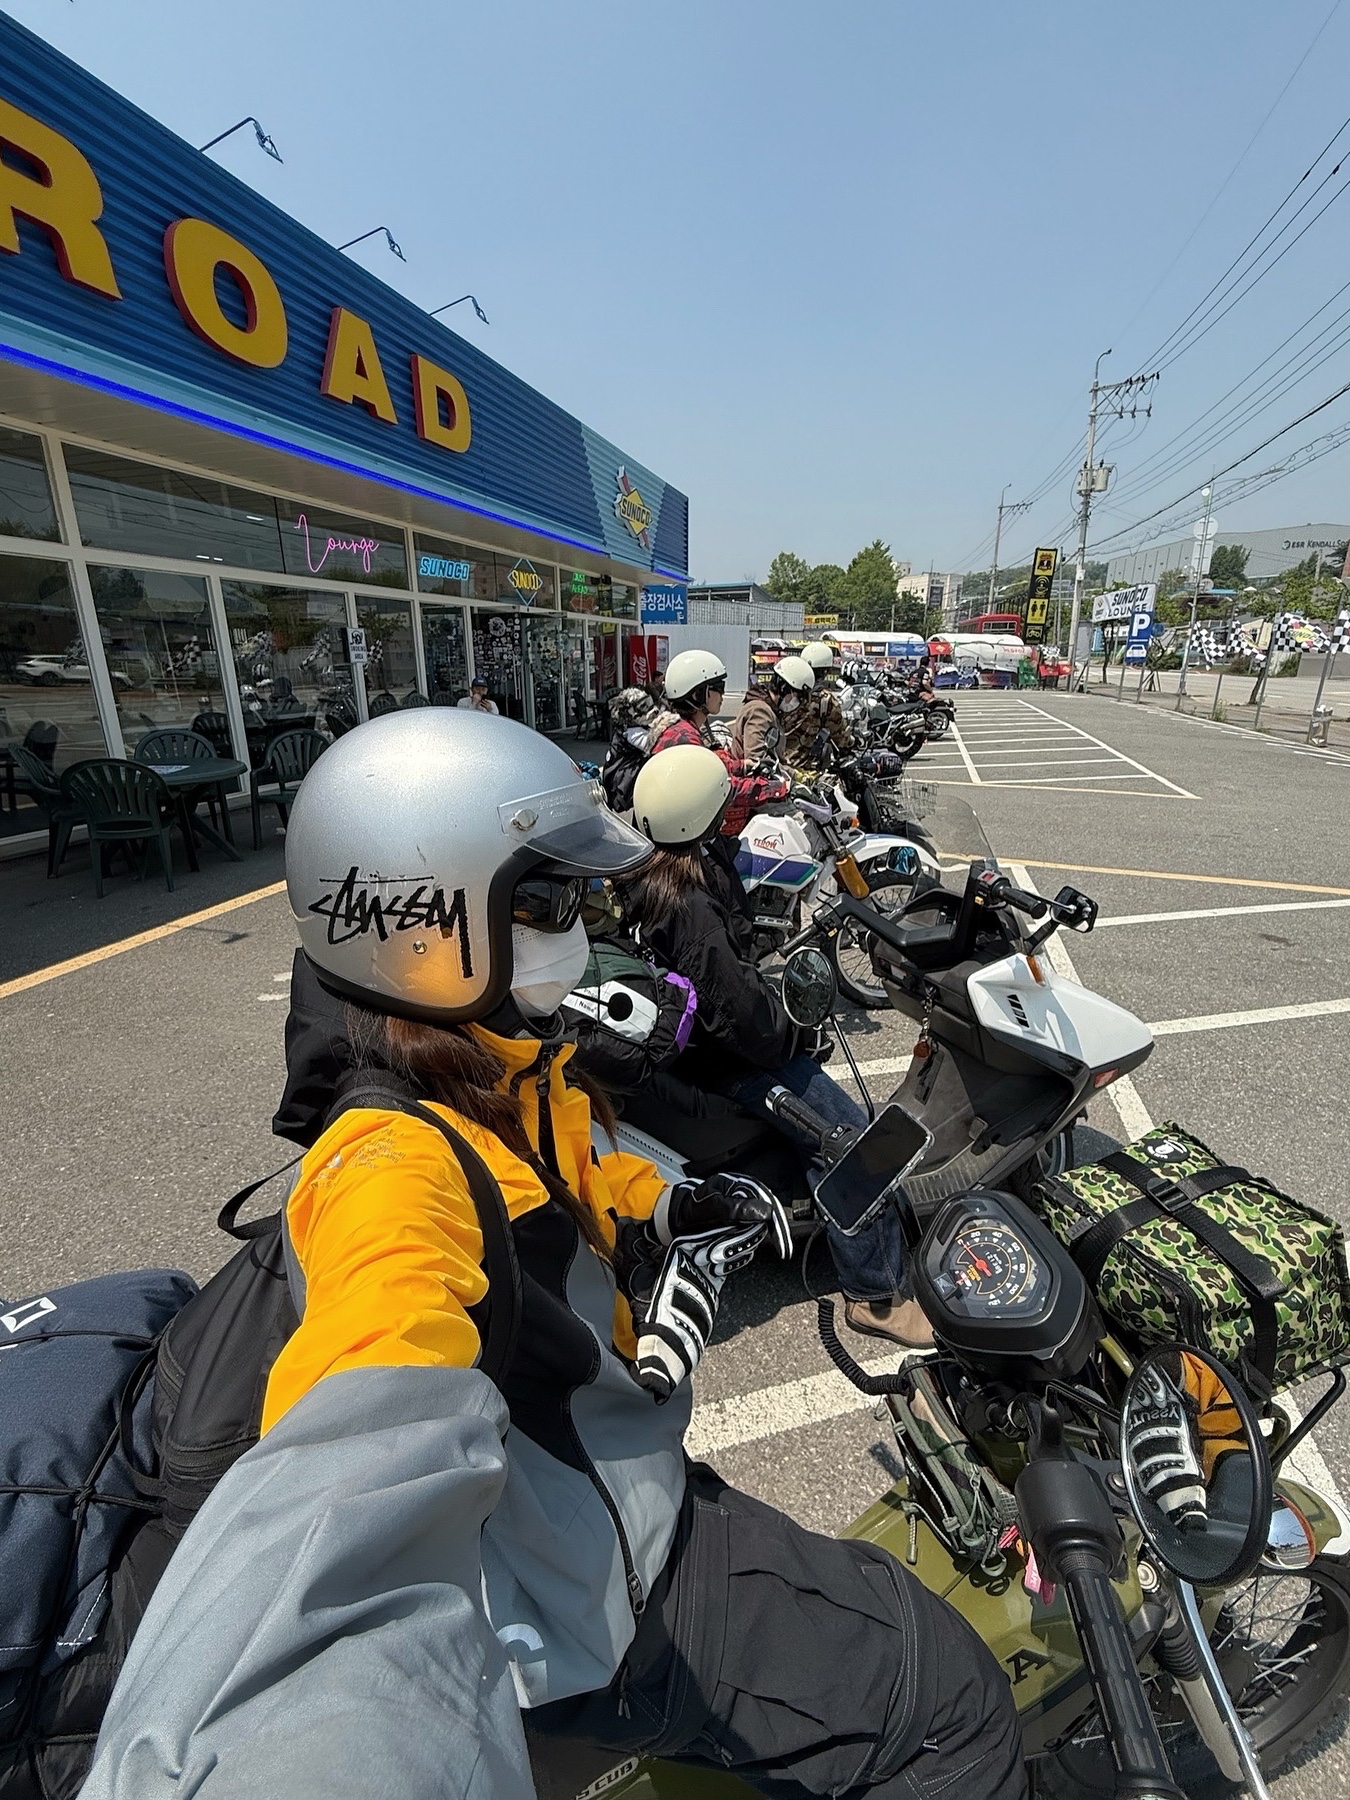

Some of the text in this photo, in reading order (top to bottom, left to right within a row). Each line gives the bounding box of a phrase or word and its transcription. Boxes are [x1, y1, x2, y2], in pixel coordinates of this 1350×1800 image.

[0, 97, 472, 454] ROAD
[621, 498, 651, 527] SUNOCO
[294, 514, 379, 573] Lounge
[1291, 541, 1305, 549] ESR
[419, 556, 471, 581] SUNOCO
[511, 570, 539, 590] SUNOCO
[1111, 588, 1149, 606] SUNOCO
[1108, 603, 1148, 617] LOUNGE
[1131, 613, 1151, 637] P
[594, 1760, 633, 1792] CUB
